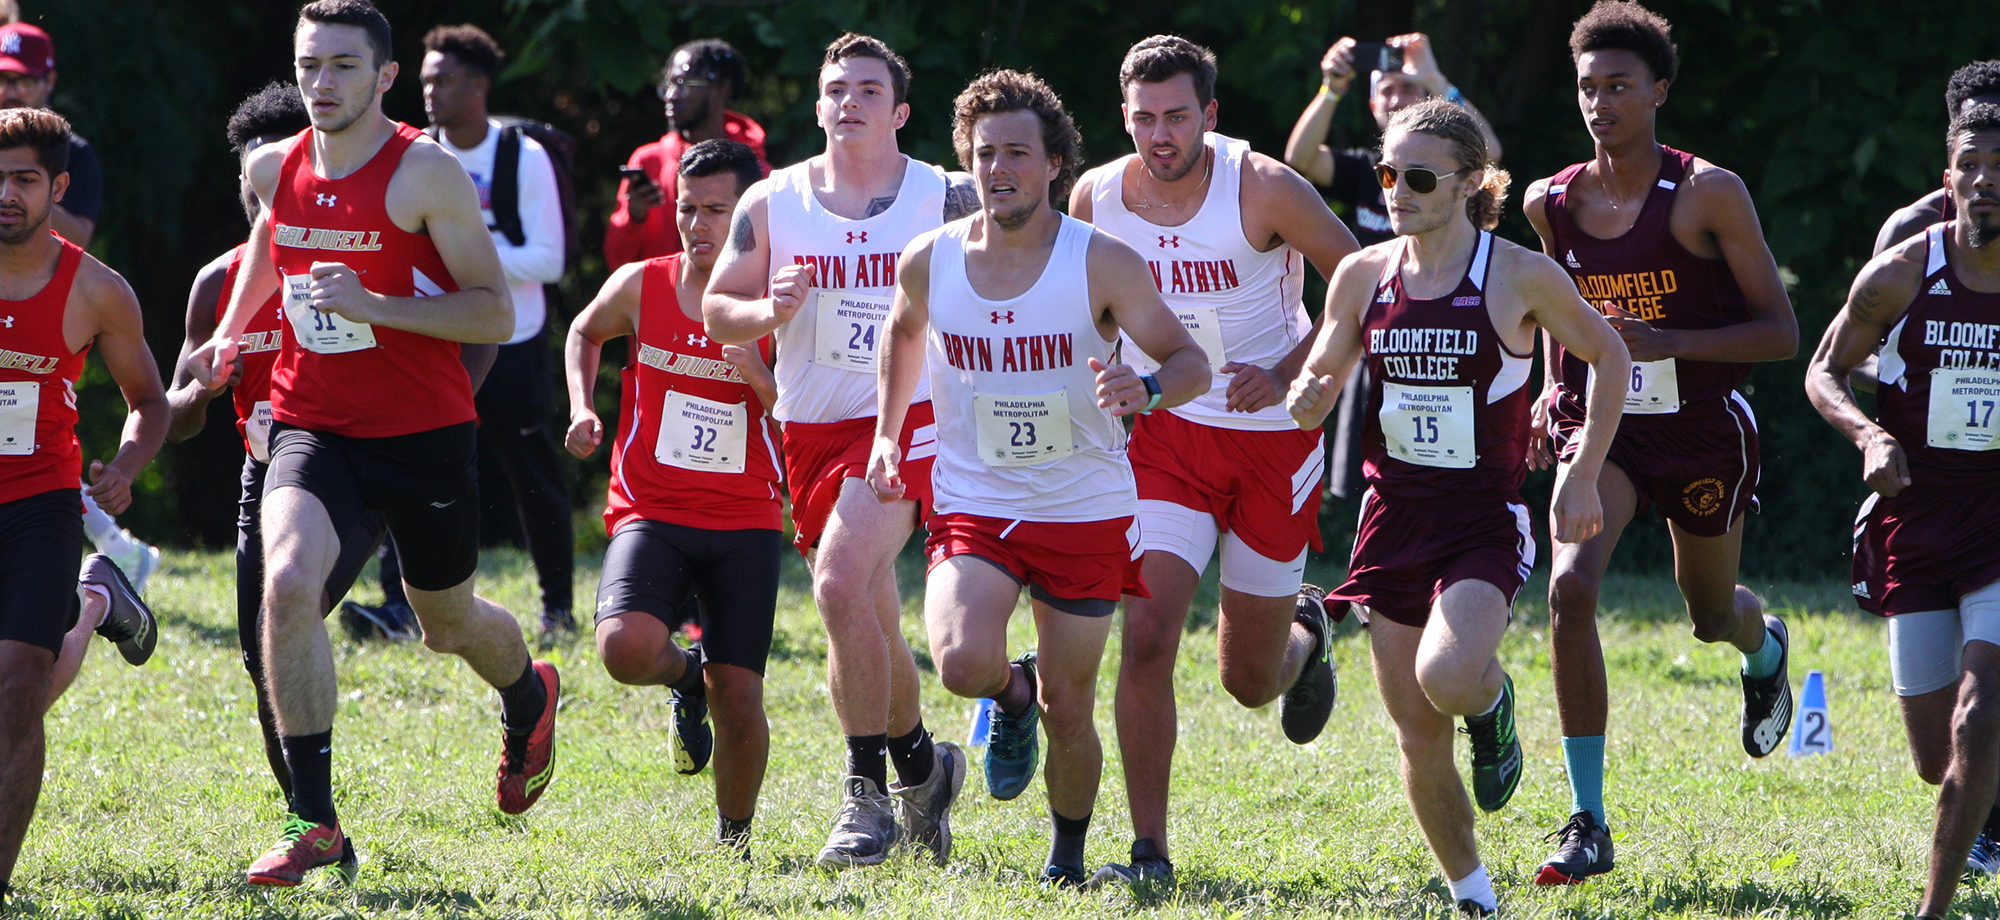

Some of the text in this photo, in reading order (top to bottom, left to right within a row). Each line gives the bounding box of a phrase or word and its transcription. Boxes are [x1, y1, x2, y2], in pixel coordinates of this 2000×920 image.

[274, 224, 383, 252] CALDWELL
[854, 252, 902, 288] ATH
[1170, 258, 1239, 294] ATHYN
[1575, 269, 1677, 299] BLOOMFIELD
[837, 309, 888, 321] METROPOLITA
[840, 299, 890, 311] PHILADELPHIA
[848, 322, 875, 351] 24
[1370, 328, 1478, 356] BLOOMFIELD
[1924, 319, 2000, 350] BLOOMF
[638, 342, 748, 384] CALDWEL
[942, 332, 1073, 373] BRYN ATHYN
[1940, 349, 2000, 371] COLLE
[1383, 355, 1459, 380] COLLEGE
[994, 400, 1046, 408] PHILADELPHIA
[1401, 392, 1450, 402] PHILADELPHIA
[1952, 387, 2000, 397] METROPOLIT
[681, 410, 734, 427] METROPOLITAN
[685, 401, 733, 417] PHILADELPHIA
[993, 409, 1049, 418] METROPOLITAN
[1398, 402, 1453, 413] METROPOLITAN
[1966, 399, 1995, 429] 17
[690, 424, 718, 453] 32
[1009, 421, 1037, 447] 23
[1412, 415, 1439, 444] 15
[1804, 711, 1826, 747] 2
